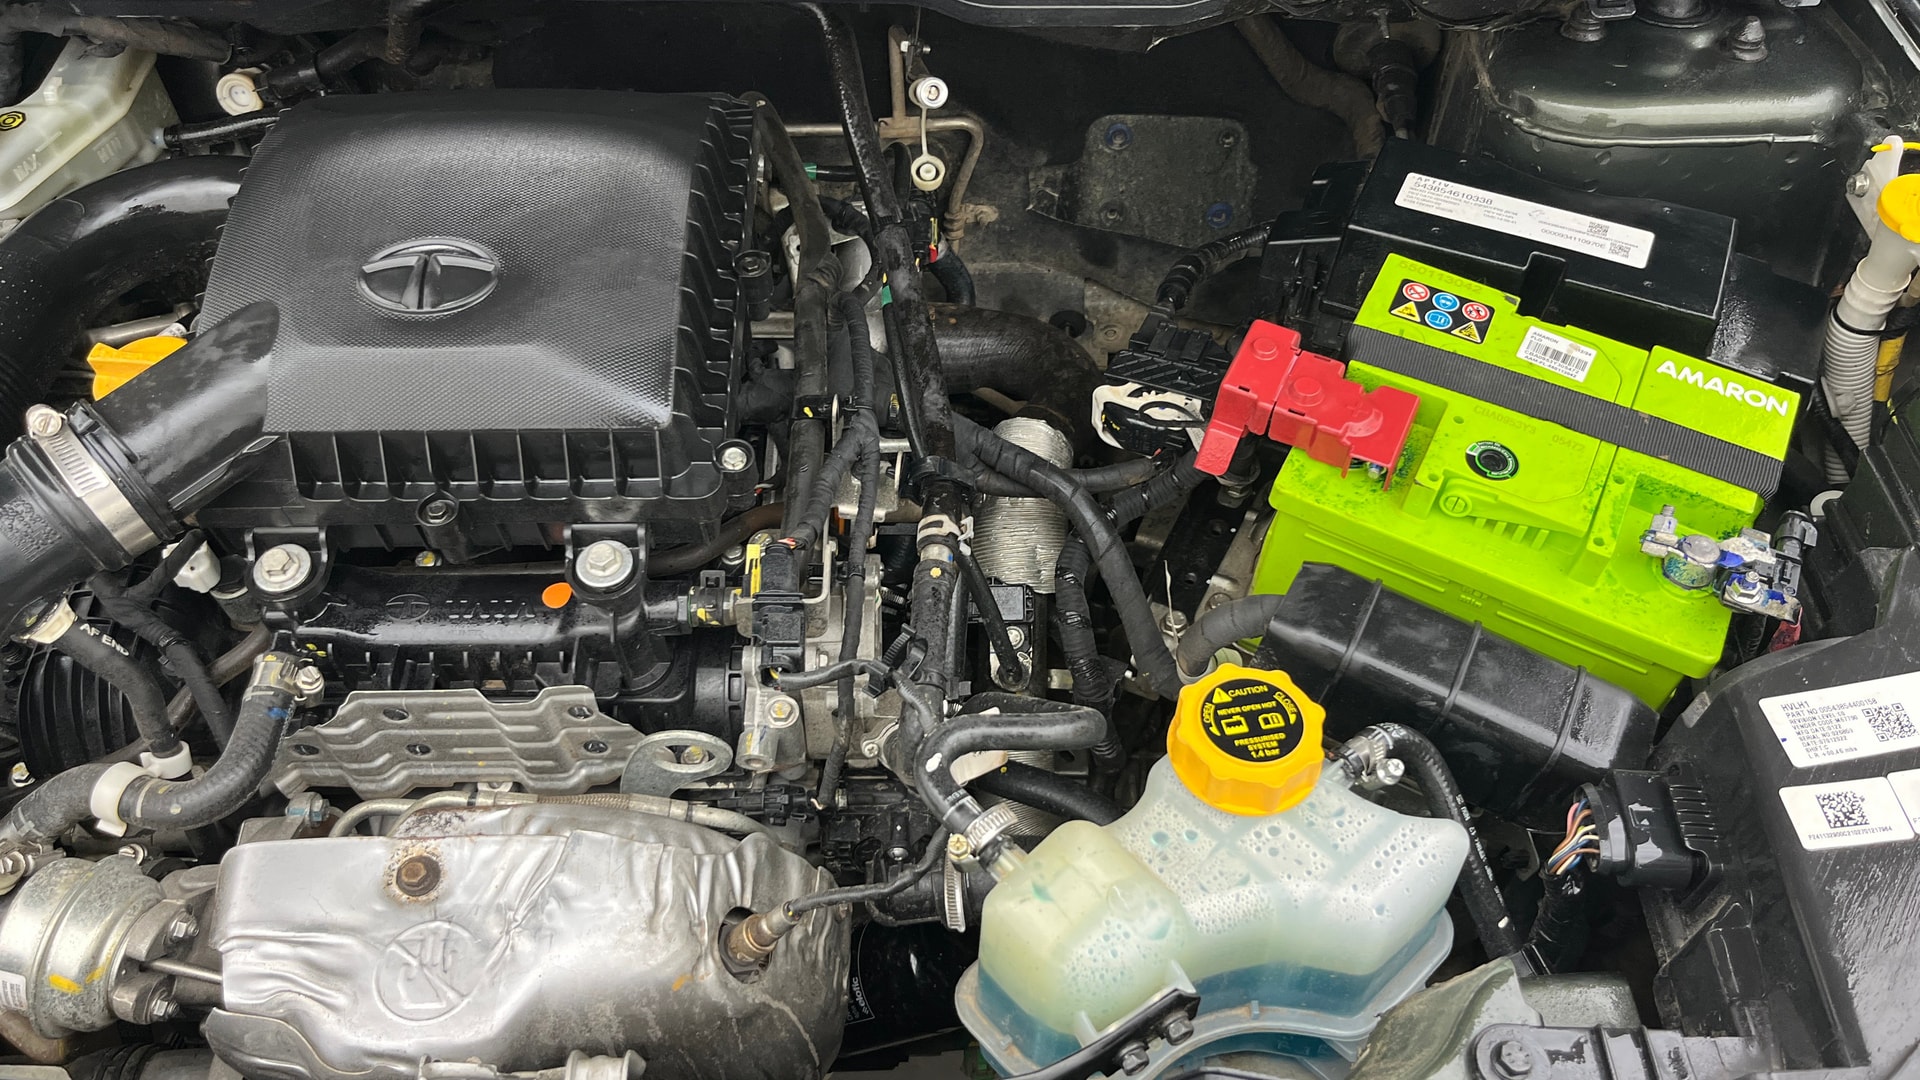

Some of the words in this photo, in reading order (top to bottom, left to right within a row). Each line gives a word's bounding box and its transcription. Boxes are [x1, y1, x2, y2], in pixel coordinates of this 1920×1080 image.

[1533, 331, 1560, 344] AMARON
[1655, 359, 1789, 418] AMARON
[102, 633, 130, 656] END
[1227, 684, 1269, 698] CAUTION
[1217, 706, 1241, 716] NEVER
[1241, 703, 1262, 713] OPEN
[1261, 700, 1277, 709] HOT
[1274, 691, 1297, 715] CLOSE
[1780, 701, 1810, 712] HVLH1
[1203, 702, 1213, 723] OPEN
[1785, 710, 1806, 719] PART
[1234, 732, 1286, 747] PRESSURISED
[1247, 740, 1279, 751] SYSTEM
[1265, 748, 1280, 757] bar
